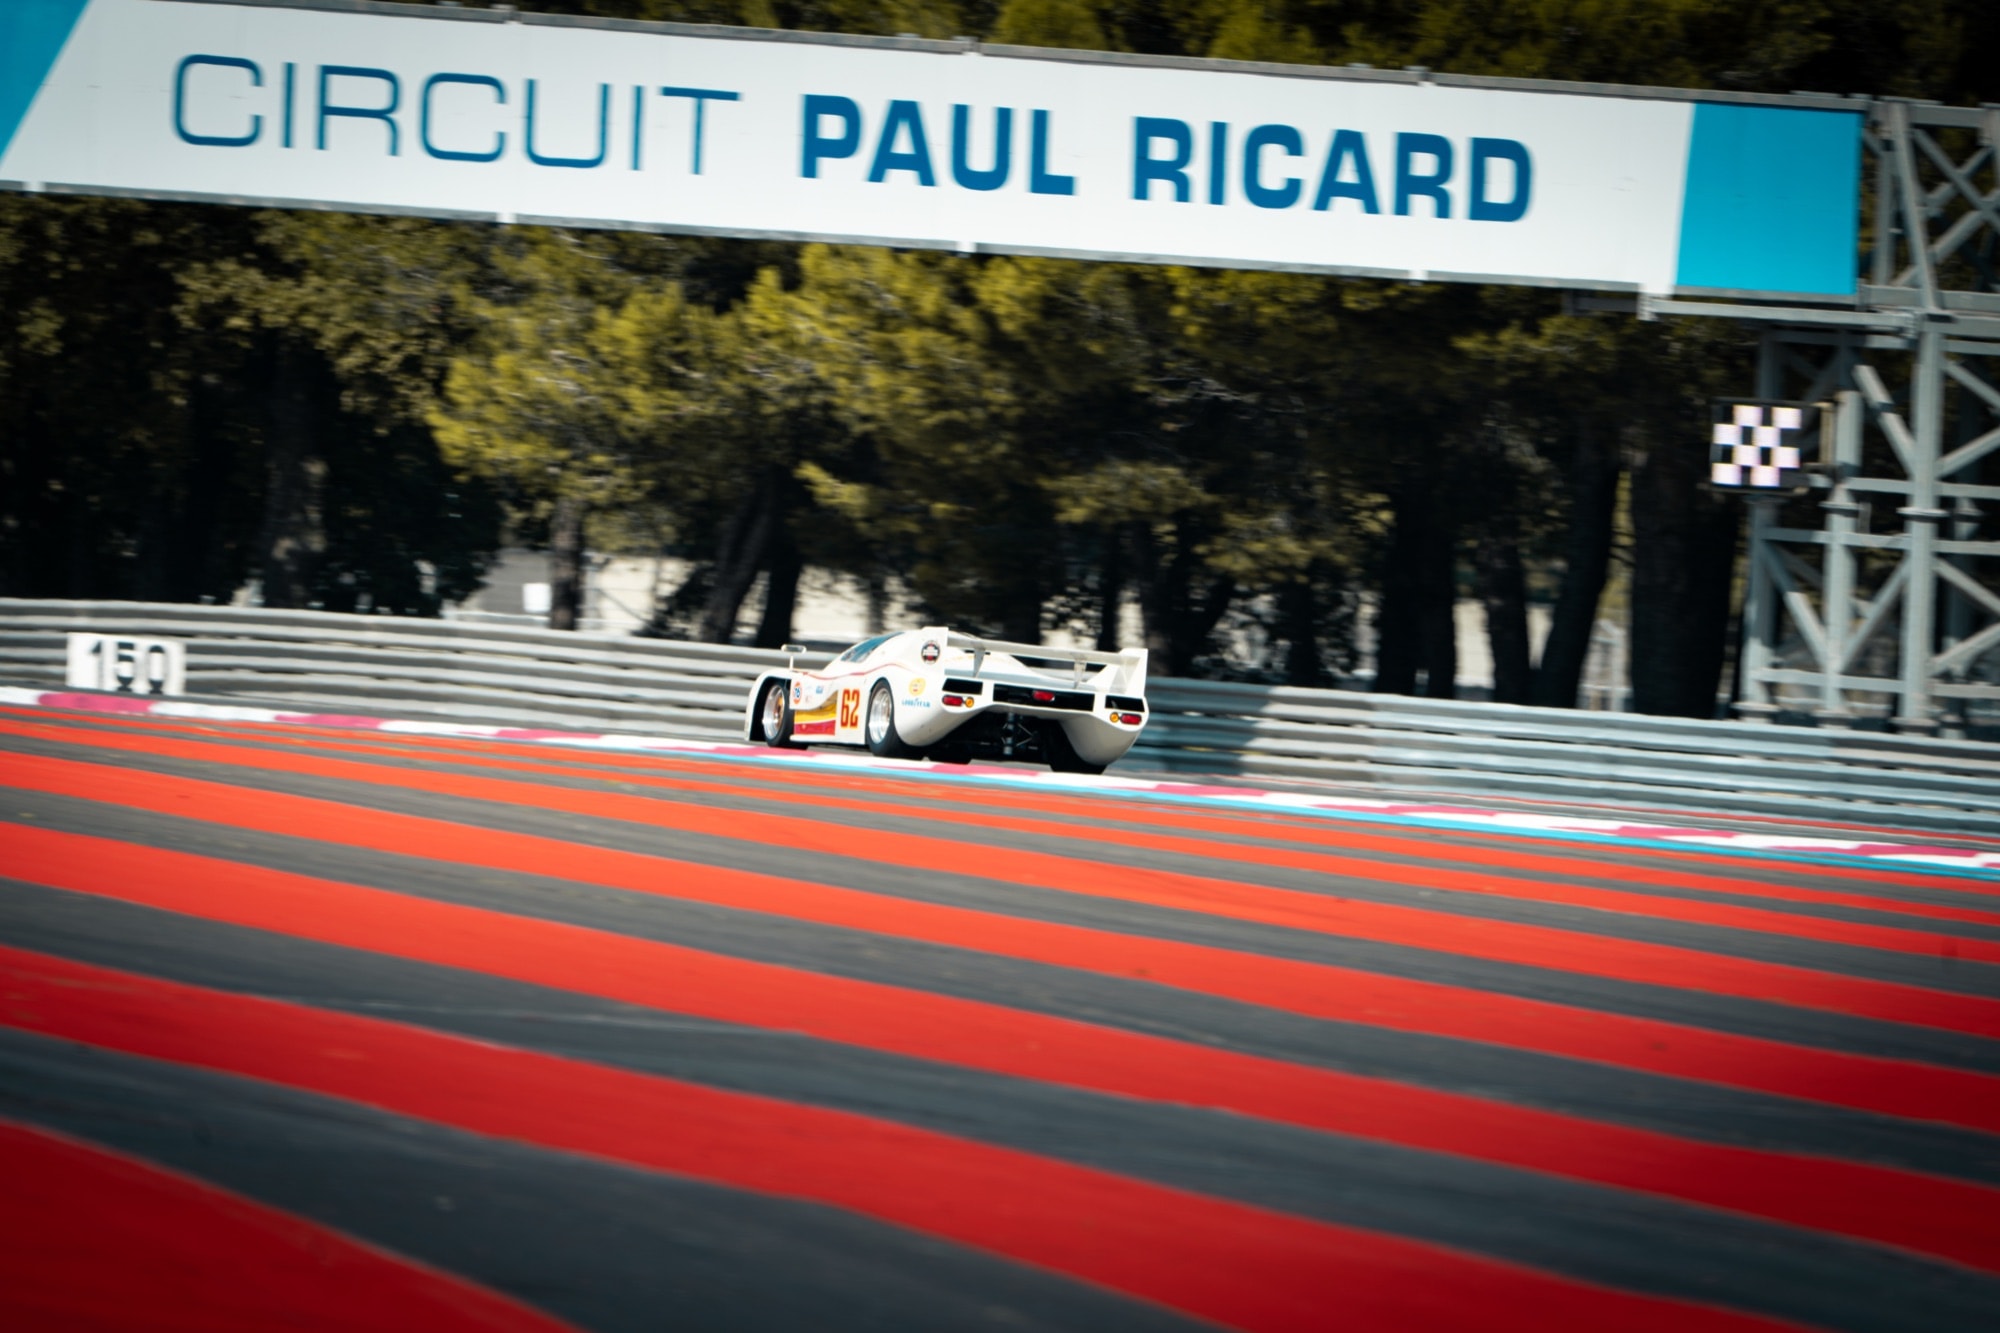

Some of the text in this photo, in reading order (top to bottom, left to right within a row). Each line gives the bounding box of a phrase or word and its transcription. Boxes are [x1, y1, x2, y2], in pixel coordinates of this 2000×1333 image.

[171, 53, 1534, 223] CIRCUIT PAUL RICARD
[90, 639, 171, 688] 150
[840, 688, 860, 728] 62
